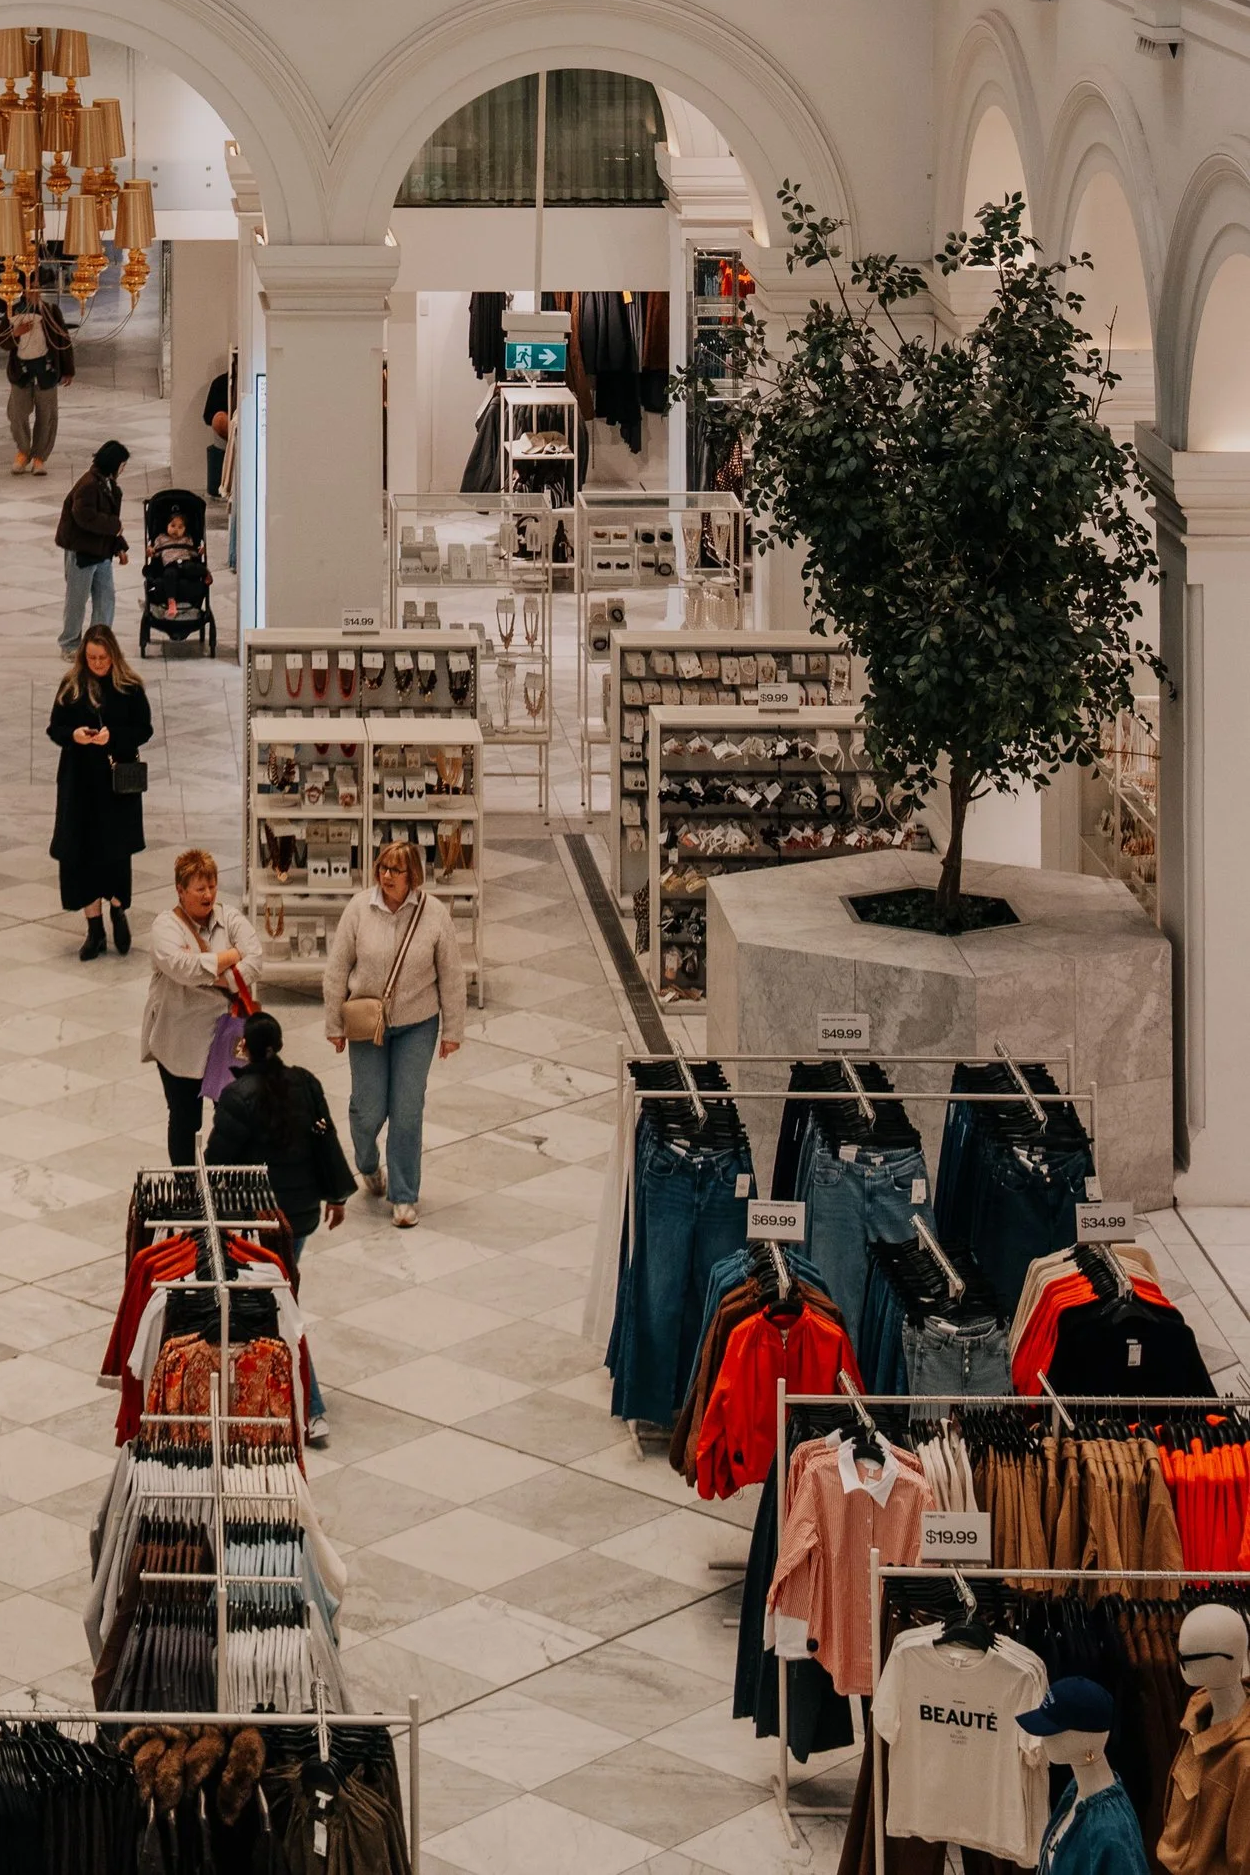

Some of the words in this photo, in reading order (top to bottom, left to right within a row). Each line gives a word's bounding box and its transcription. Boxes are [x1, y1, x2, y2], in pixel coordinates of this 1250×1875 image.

[344, 617, 374, 626] $14.99
[760, 693, 789, 703] $9.99
[821, 1028, 862, 1040] $49.99
[751, 1214, 796, 1227] $69.99
[1080, 1216, 1126, 1229] $34.99
[925, 1529, 978, 1545] $19.99
[919, 1704, 998, 1733] BEAUTÉ
